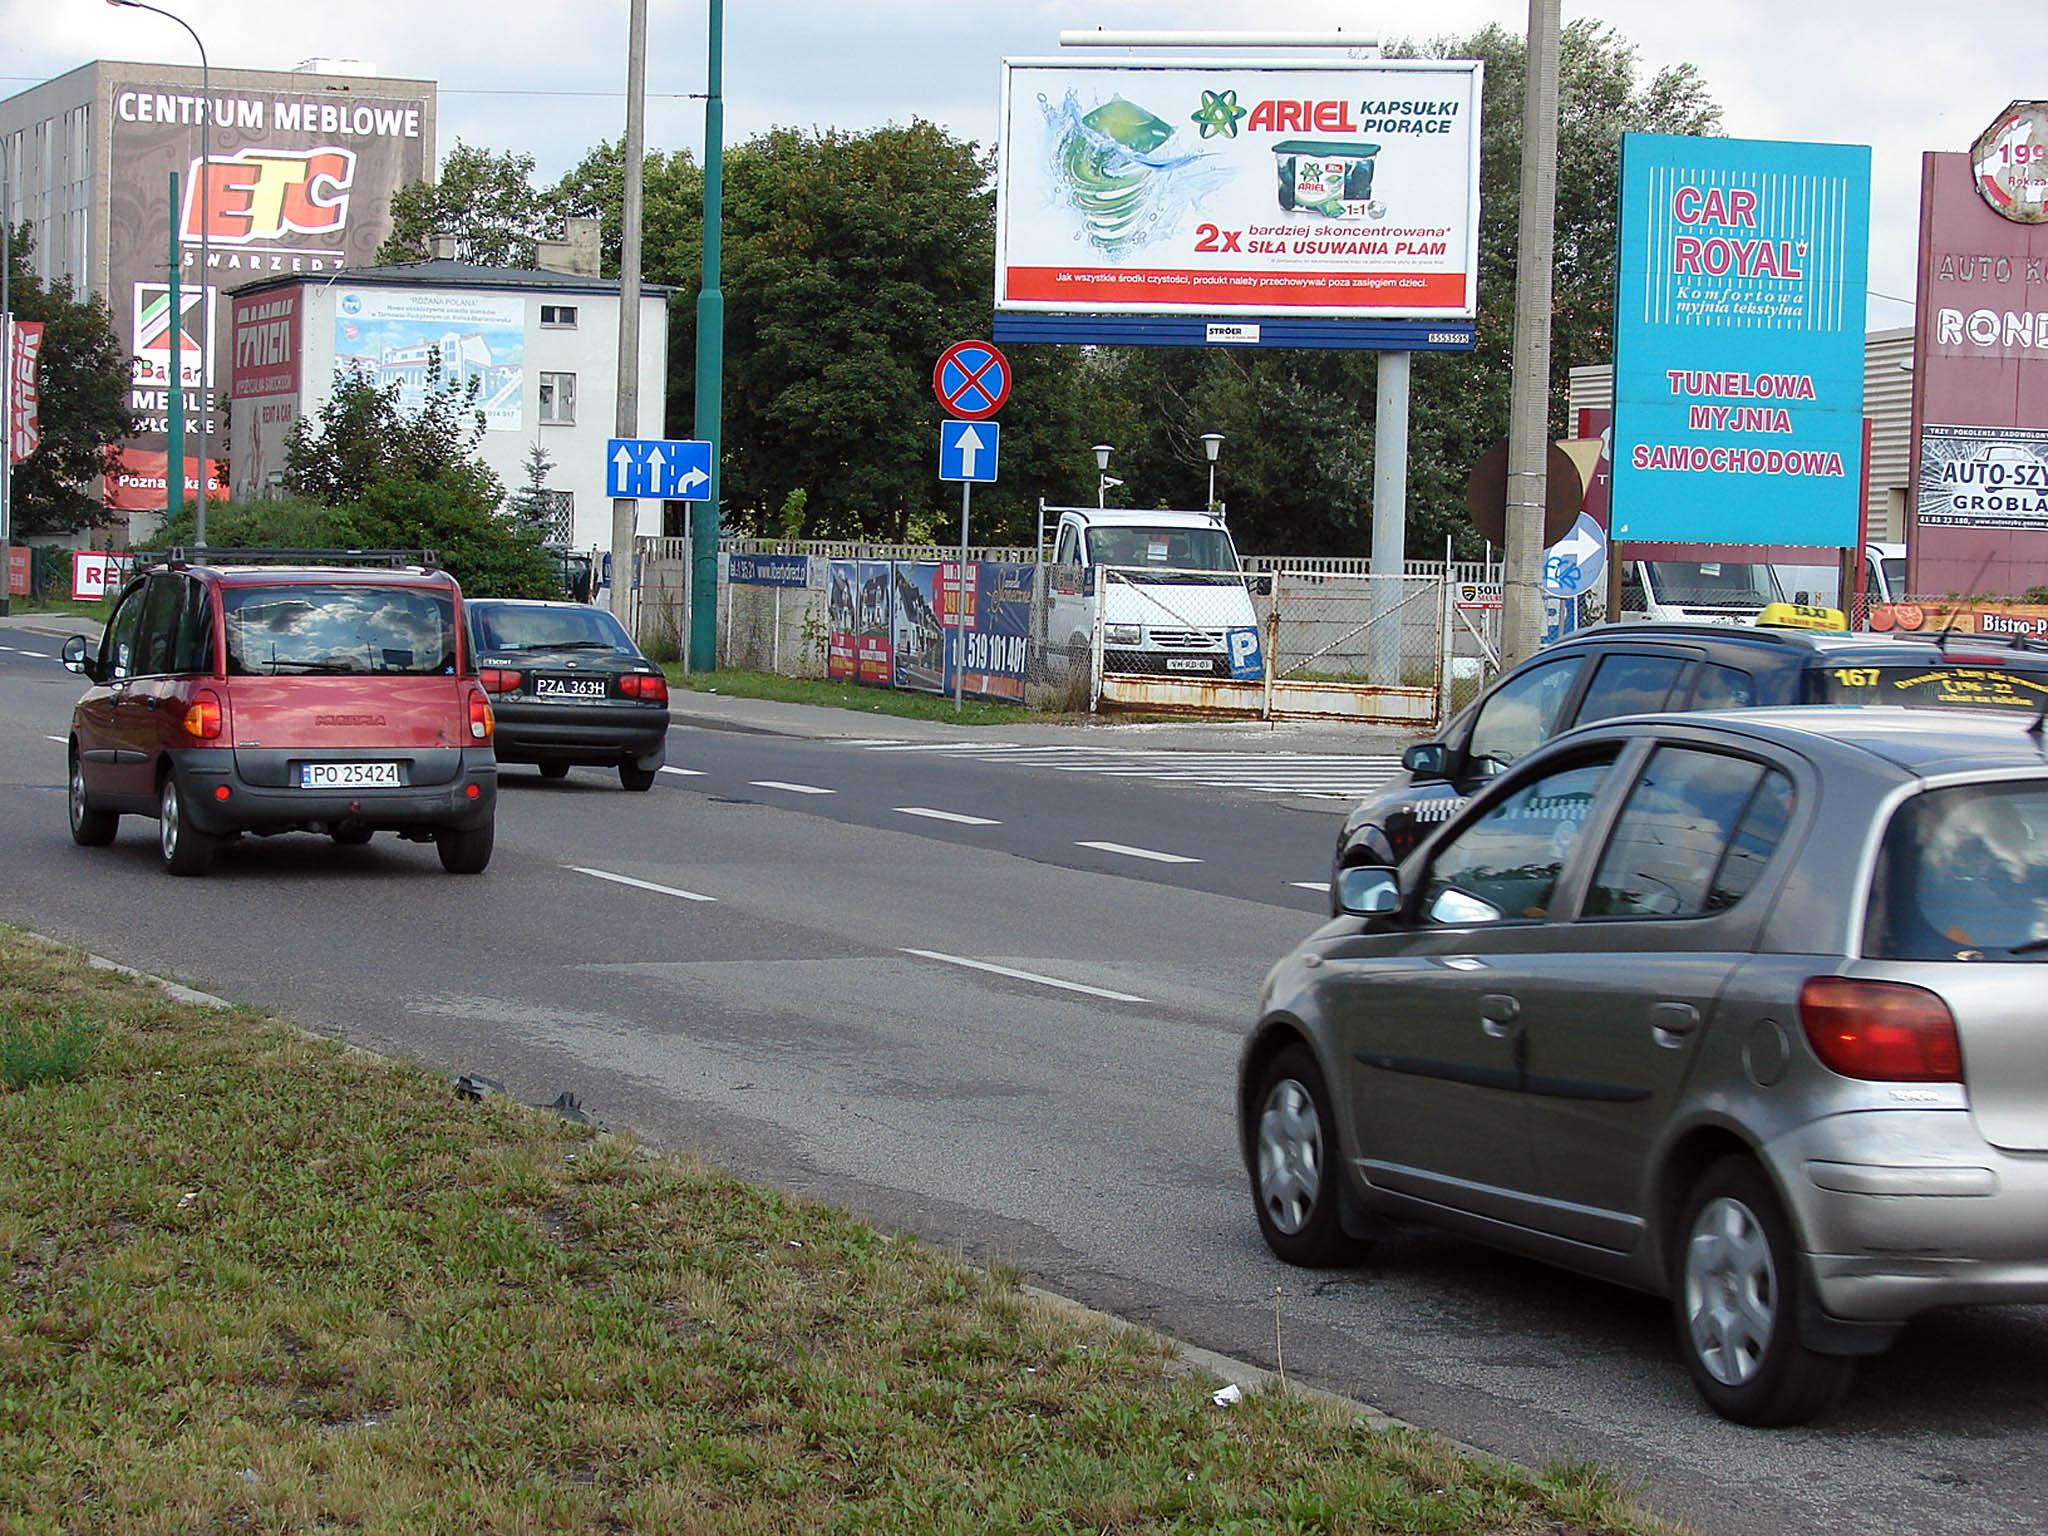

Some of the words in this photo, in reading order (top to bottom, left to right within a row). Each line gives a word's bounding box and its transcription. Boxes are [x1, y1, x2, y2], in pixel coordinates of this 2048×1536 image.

[118, 91, 264, 129] CENTRUM
[274, 101, 420, 138] MEBLOWE
[1248, 100, 1357, 132] ARIEL
[1360, 101, 1459, 116] KAPSUŁKI
[1364, 119, 1452, 137] PIORĄCE
[2008, 176, 2030, 187] Rok
[2033, 178, 2048, 187] za
[179, 146, 357, 244] ETC
[1674, 187, 1757, 228] CAR
[1194, 223, 1242, 254] 2x
[1248, 225, 1311, 239] bardziej
[1248, 240, 1286, 254] SIŁA
[1293, 241, 1389, 255] USUWANIA
[1395, 242, 1446, 256] PLAM
[1674, 237, 1801, 279] ROYAL
[1939, 255, 2012, 284] AUTO
[2025, 257, 2048, 286] K
[1056, 273, 1073, 282] Jak
[1074, 273, 1116, 284] wszystkie
[1193, 276, 1228, 286] produkt
[1229, 276, 1258, 287] należy
[1259, 277, 1326, 289] przechowywać
[1328, 279, 1350, 290] poza
[1352, 278, 1397, 289] zasięgiem
[1399, 278, 1428, 288] dzieci.
[1676, 286, 1803, 304] Komfortowa
[1676, 301, 1729, 317] myjnia
[1733, 302, 1803, 318] tekstylna
[141, 360, 202, 382] Baar
[1666, 370, 1816, 400] TUNELOWA
[1689, 405, 1792, 433] MYJNIA
[1953, 428, 1996, 437] POKOLENIA
[1633, 445, 1845, 477] SAMOCHODOWA
[118, 475, 201, 490] Poznaka
[86, 566, 131, 585] RE
[1793, 606, 1827, 619] TAXI
[953, 637, 967, 667] tl.
[968, 632, 988, 669] 519
[989, 634, 1006, 672] 101
[1007, 636, 1027, 673] 401
[1230, 632, 1258, 668] P
[537, 679, 565, 693] PZA
[571, 680, 605, 695] 363H
[1834, 669, 1880, 686] 167
[314, 766, 338, 783] PO
[344, 765, 395, 782] 25424
